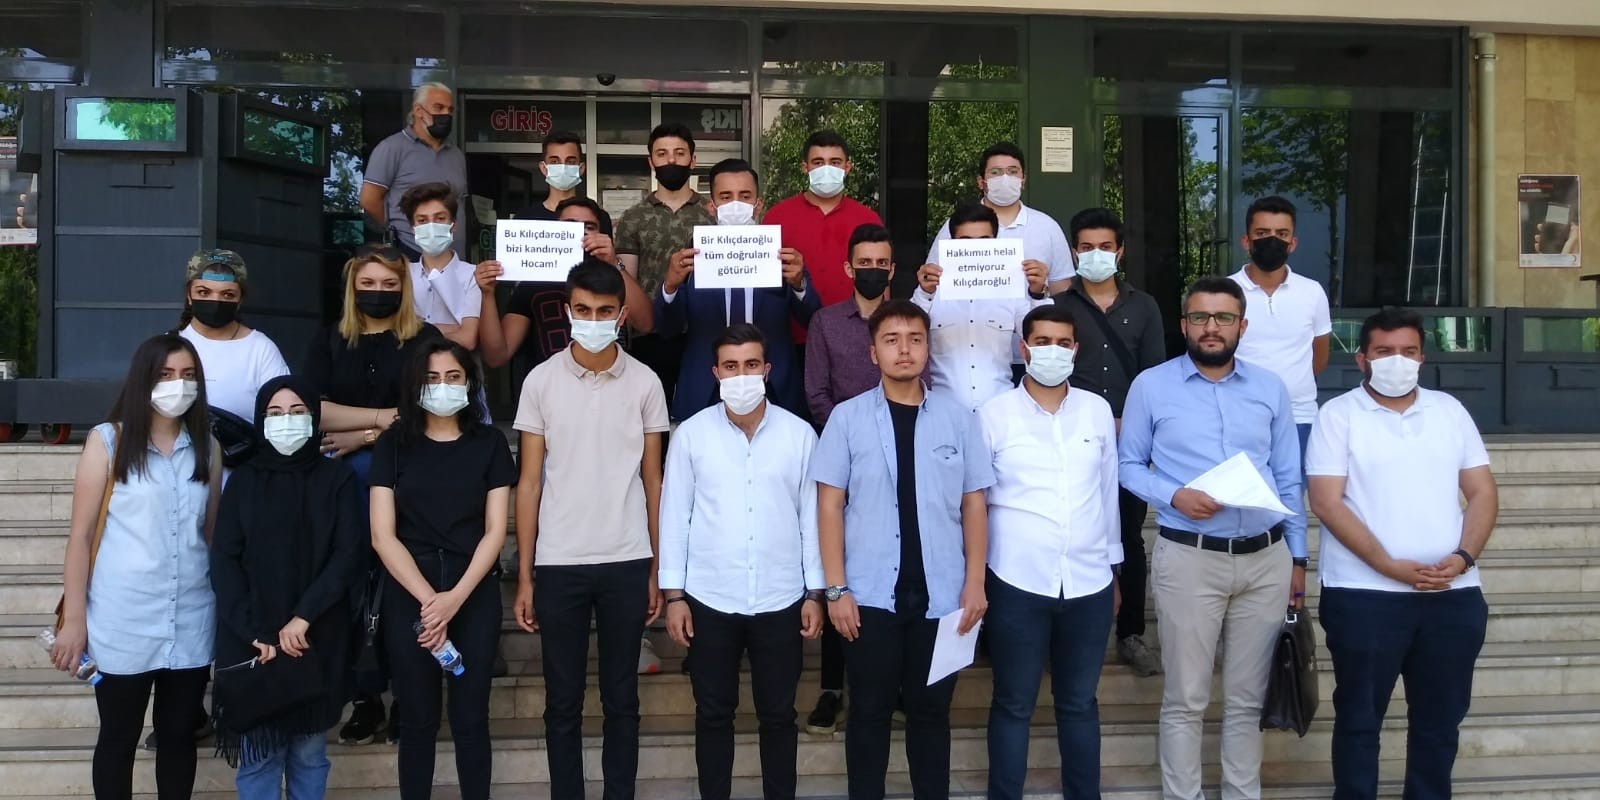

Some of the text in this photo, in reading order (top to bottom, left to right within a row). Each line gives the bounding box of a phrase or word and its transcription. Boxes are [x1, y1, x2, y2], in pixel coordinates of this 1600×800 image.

[490, 104, 553, 137] GİRİŞ
[504, 229, 575, 241] Bu Kılıçdaroğlu
[700, 234, 773, 246] Bir Kılıçdaroğlu
[506, 244, 574, 256] bizi kandırıyor
[704, 250, 770, 261] tüm doğruları
[946, 247, 1016, 258] Hakkımızı helal
[521, 259, 558, 269] Hocam!
[957, 262, 1006, 273] etmiyoruz
[717, 264, 758, 277] götürür!
[953, 276, 1011, 289] Kılıçdaroğlu!
